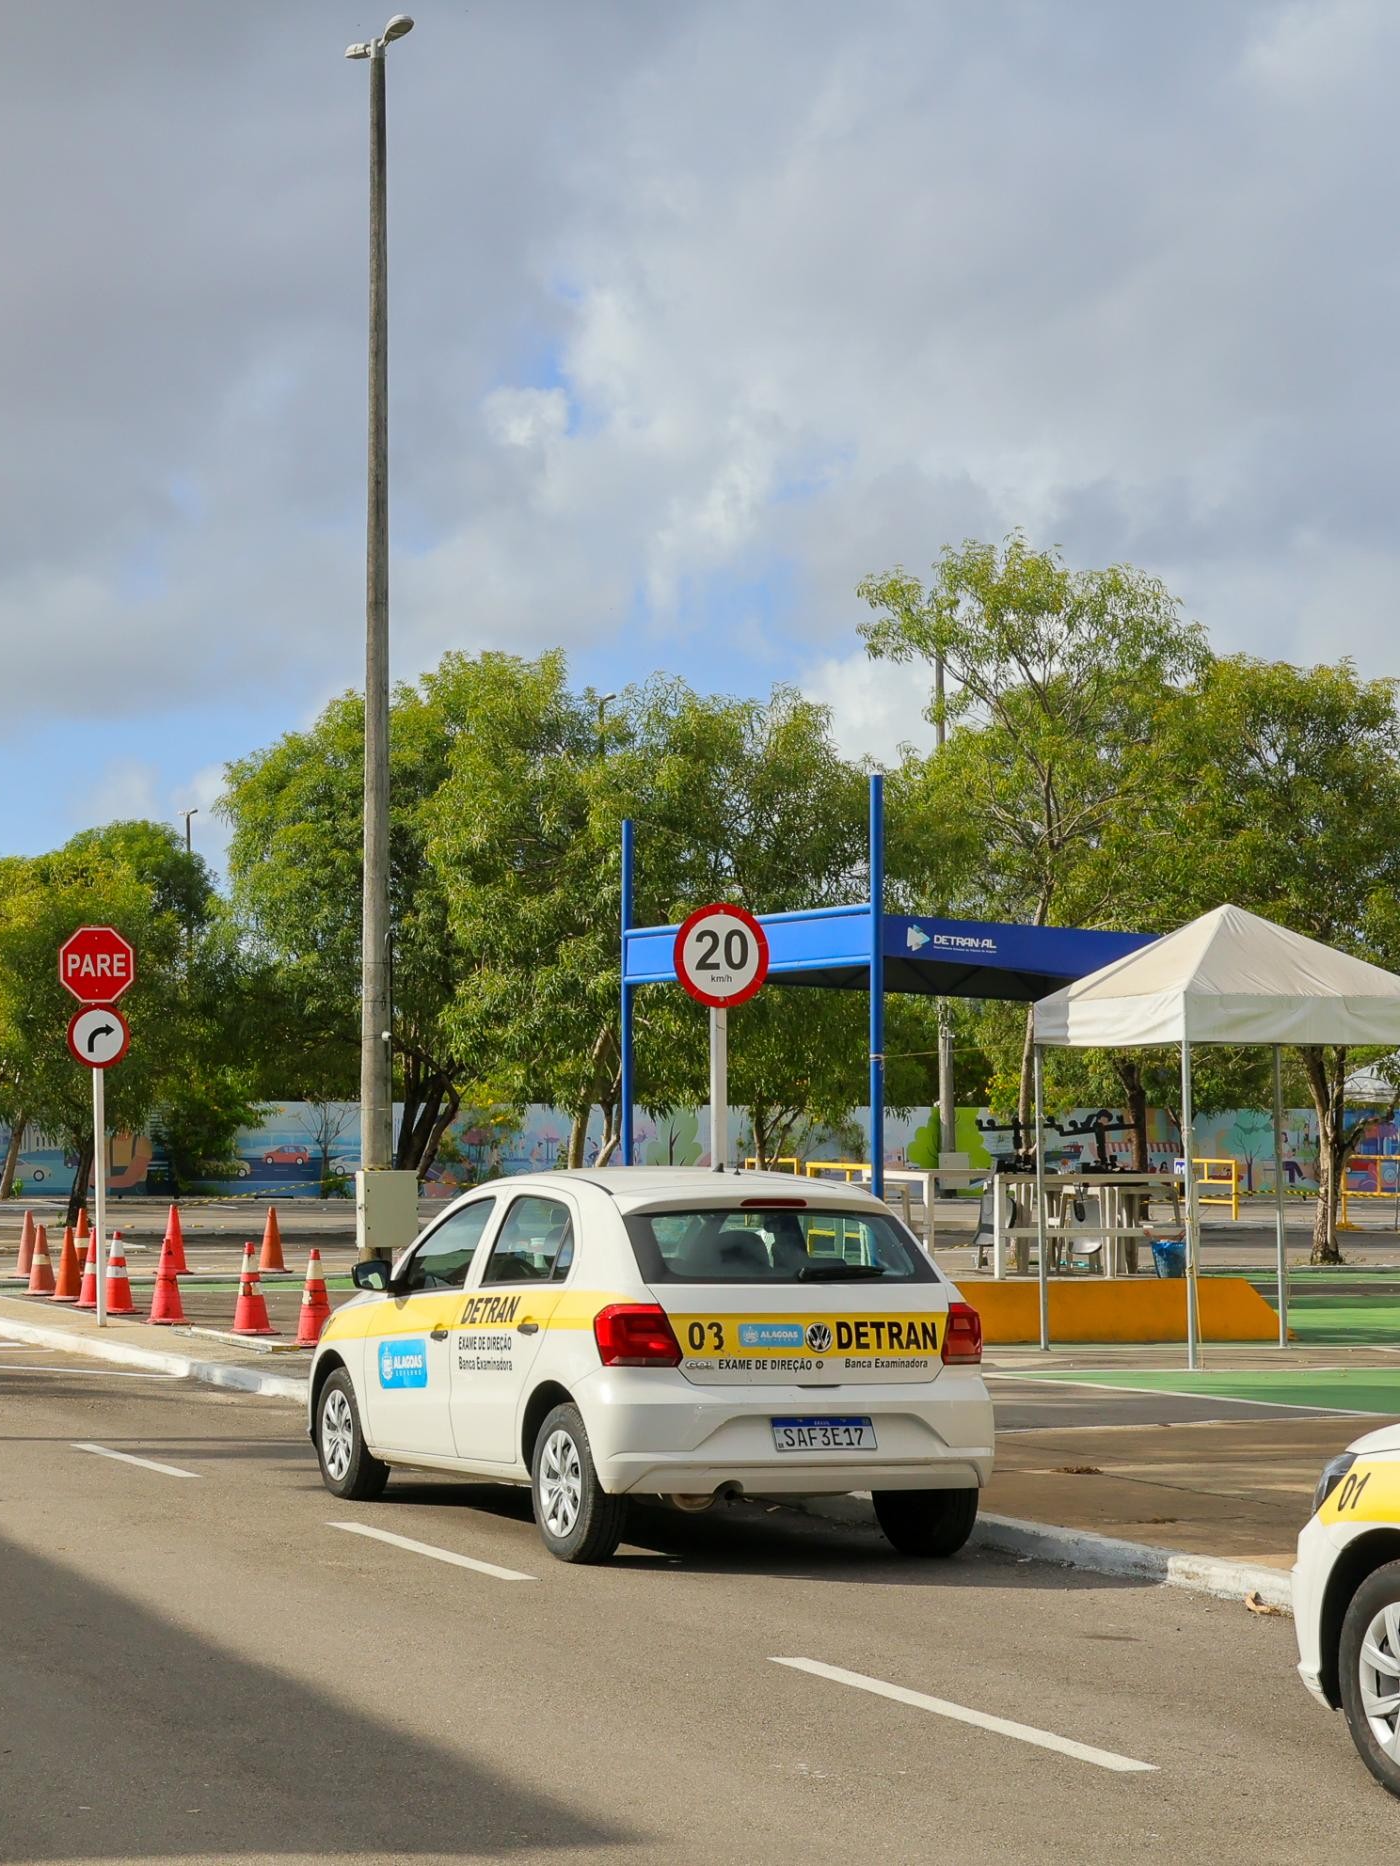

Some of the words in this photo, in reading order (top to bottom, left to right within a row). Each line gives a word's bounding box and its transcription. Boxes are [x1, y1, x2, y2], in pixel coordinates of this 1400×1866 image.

[695, 929, 749, 971] 20
[67, 953, 127, 977] PARE
[710, 974, 733, 983] km/h
[460, 1296, 522, 1325] DETRAN
[458, 1336, 477, 1351] EXAME
[478, 1336, 486, 1351] DE
[487, 1333, 512, 1354] DIREÇÃO
[687, 1321, 725, 1351] 03
[760, 1330, 799, 1339] ALAGOAS
[835, 1320, 938, 1350] DETRAN
[393, 1354, 424, 1369] ALAGOAS
[458, 1356, 476, 1370] Banca
[477, 1356, 513, 1371] Examinadora
[718, 1359, 752, 1370] EXAME
[755, 1359, 768, 1370] DE
[770, 1358, 813, 1373] DIREÇÃO
[844, 1358, 872, 1369] Banca
[874, 1358, 929, 1369] Examinadora
[783, 1427, 865, 1447] SAF3E17
[1337, 1471, 1372, 1512] 01
